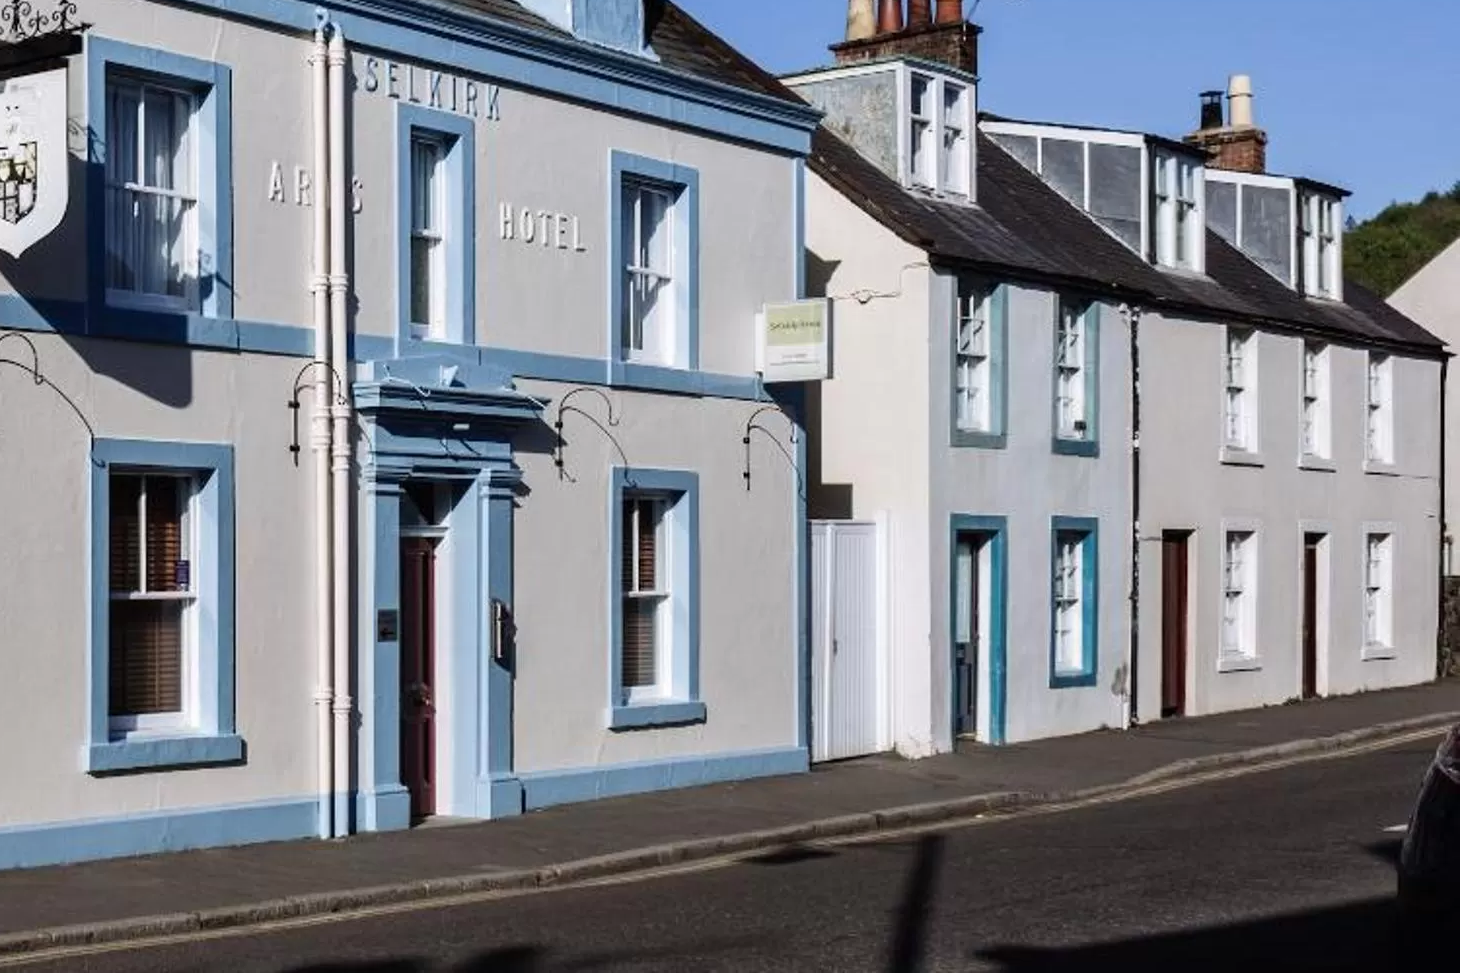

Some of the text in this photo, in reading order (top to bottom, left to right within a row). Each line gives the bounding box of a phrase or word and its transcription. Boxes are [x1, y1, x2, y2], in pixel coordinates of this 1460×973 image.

[363, 56, 501, 122] SELKIRK
[267, 159, 364, 215] ARS
[499, 201, 587, 253] HOTEL
